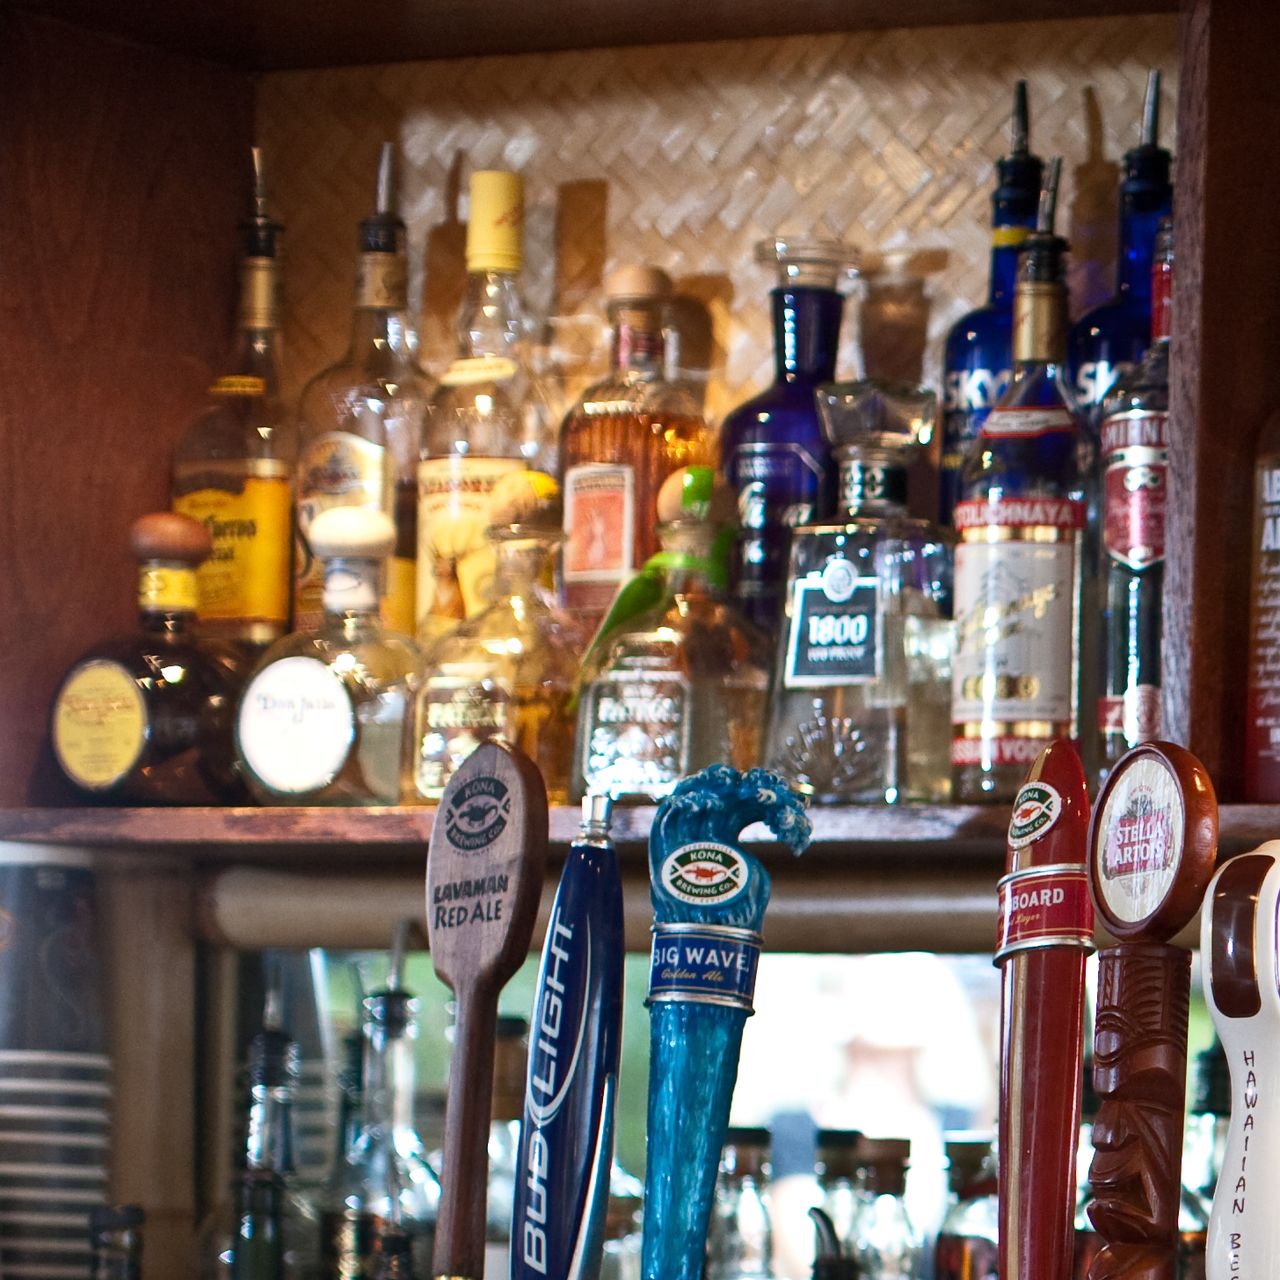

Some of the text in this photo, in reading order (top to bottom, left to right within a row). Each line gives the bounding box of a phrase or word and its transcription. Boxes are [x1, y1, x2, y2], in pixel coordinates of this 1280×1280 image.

[808, 614, 869, 645] 1800
[464, 781, 496, 800] KONA
[447, 827, 490, 849] BREWING
[1116, 820, 1165, 843] STELLA
[690, 850, 724, 863] KONA
[1115, 841, 1166, 866] ARTOIS
[434, 874, 509, 904] LAVAMAN
[675, 879, 718, 895] BREWING
[434, 899, 503, 930] RED ALE
[661, 967, 724, 982] Golden Ale
[523, 905, 575, 1276] BUD LIGHT
[1230, 1048, 1258, 1217] HAWAIIAN
